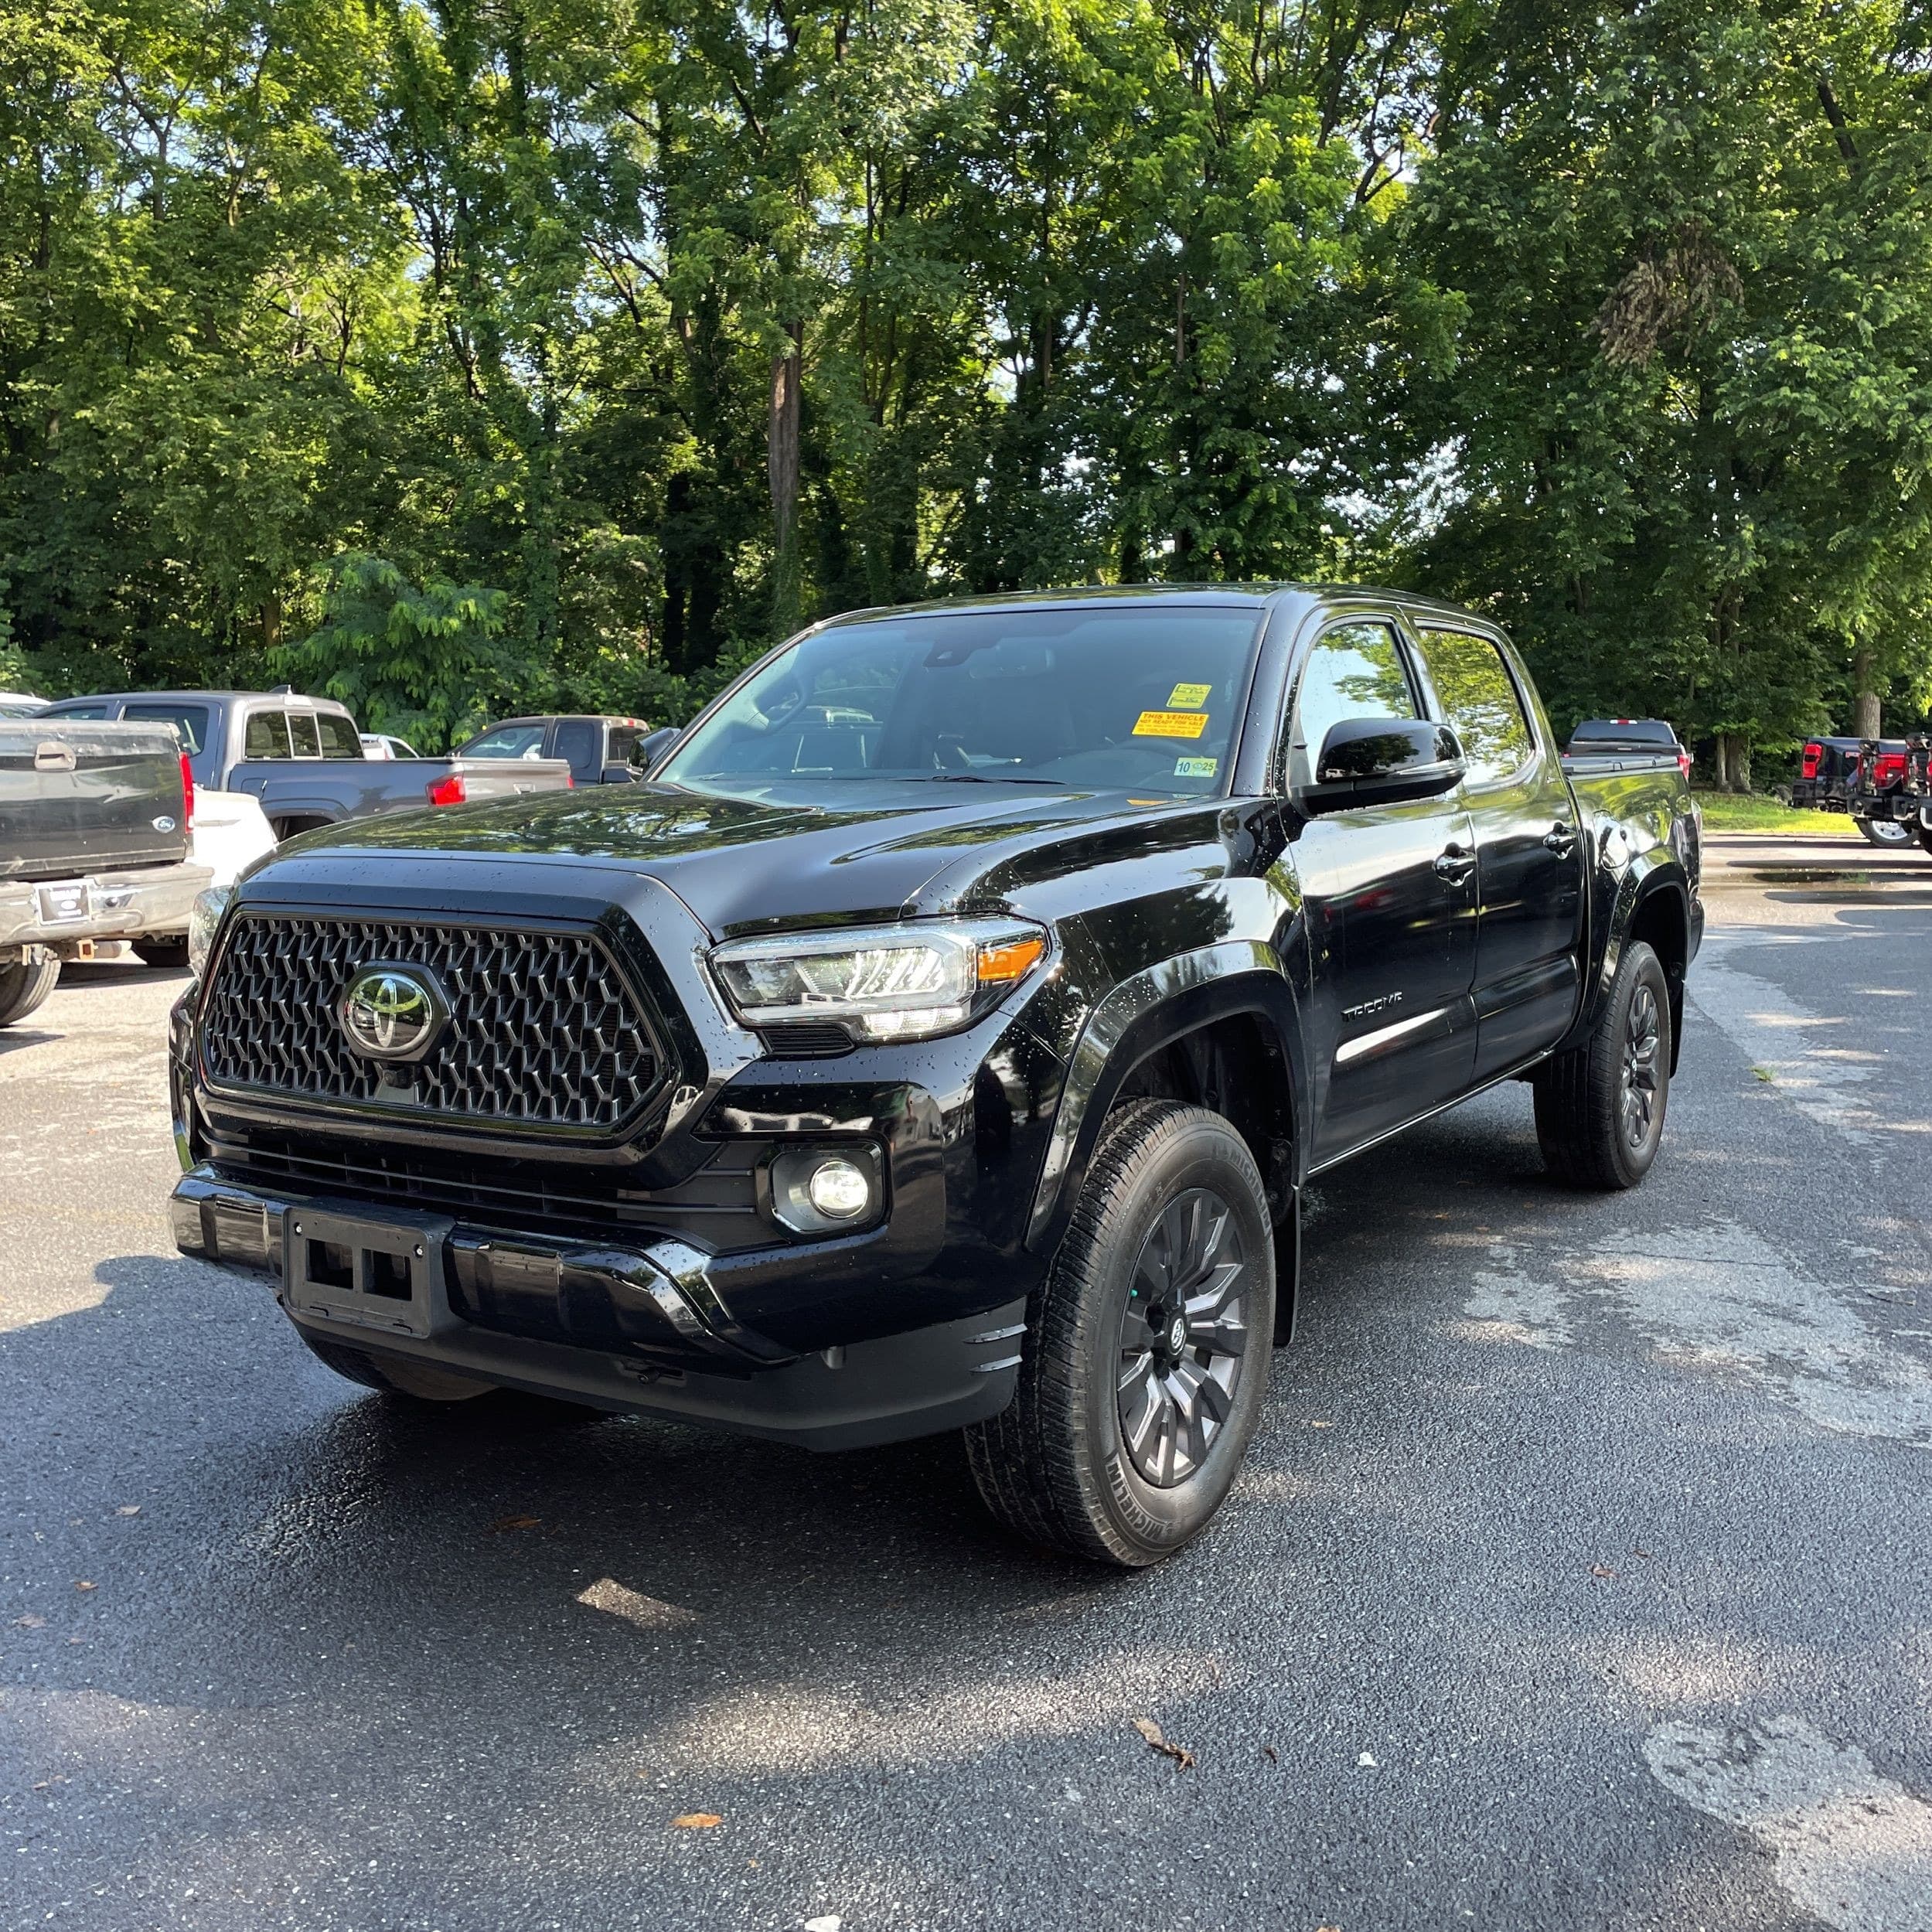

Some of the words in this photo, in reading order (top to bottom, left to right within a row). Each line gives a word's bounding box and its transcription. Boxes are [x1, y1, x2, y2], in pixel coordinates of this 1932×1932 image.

[1178, 762, 1191, 773] 10
[1201, 762, 1214, 771] 25
[1227, 1147, 1272, 1229] MICHELIN
[1106, 1462, 1164, 1541] MICHELIN
